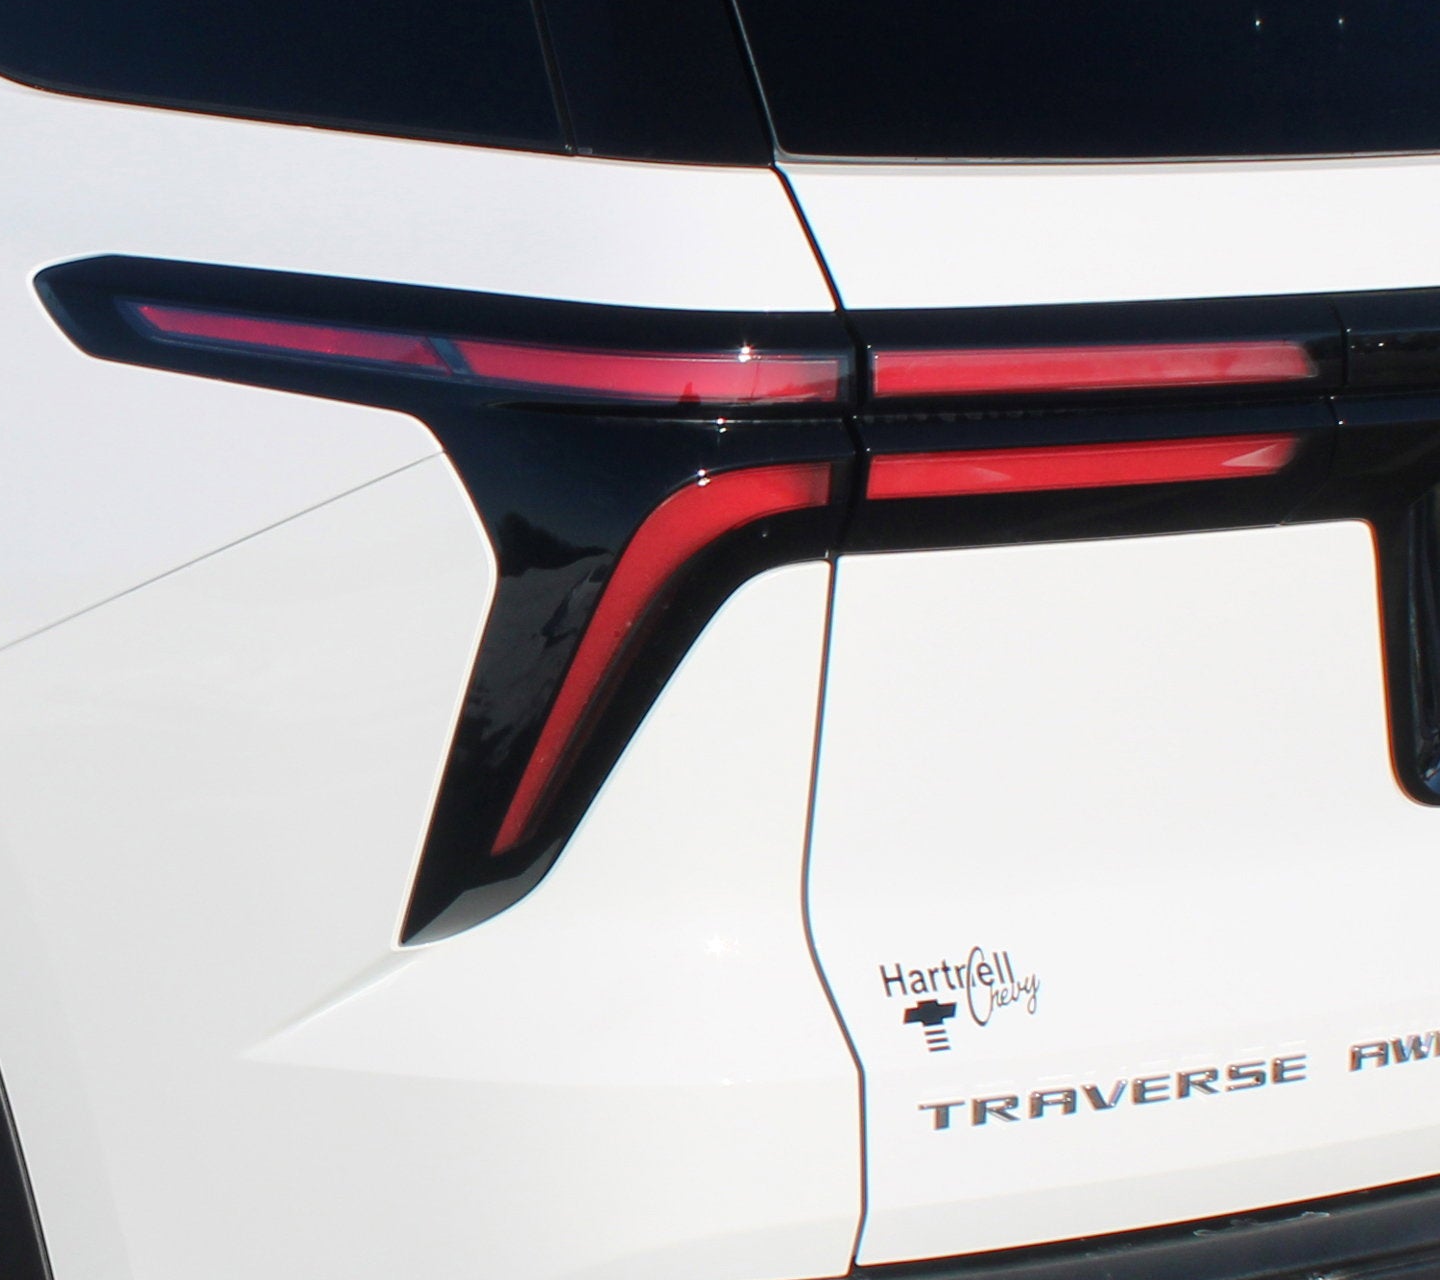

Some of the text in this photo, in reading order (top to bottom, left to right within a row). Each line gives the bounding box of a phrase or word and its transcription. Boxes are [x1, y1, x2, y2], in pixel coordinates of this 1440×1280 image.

[879, 950, 1016, 998] Hartnell
[967, 945, 1040, 1027] Chevy
[918, 1053, 1308, 1131] TRAVERSE
